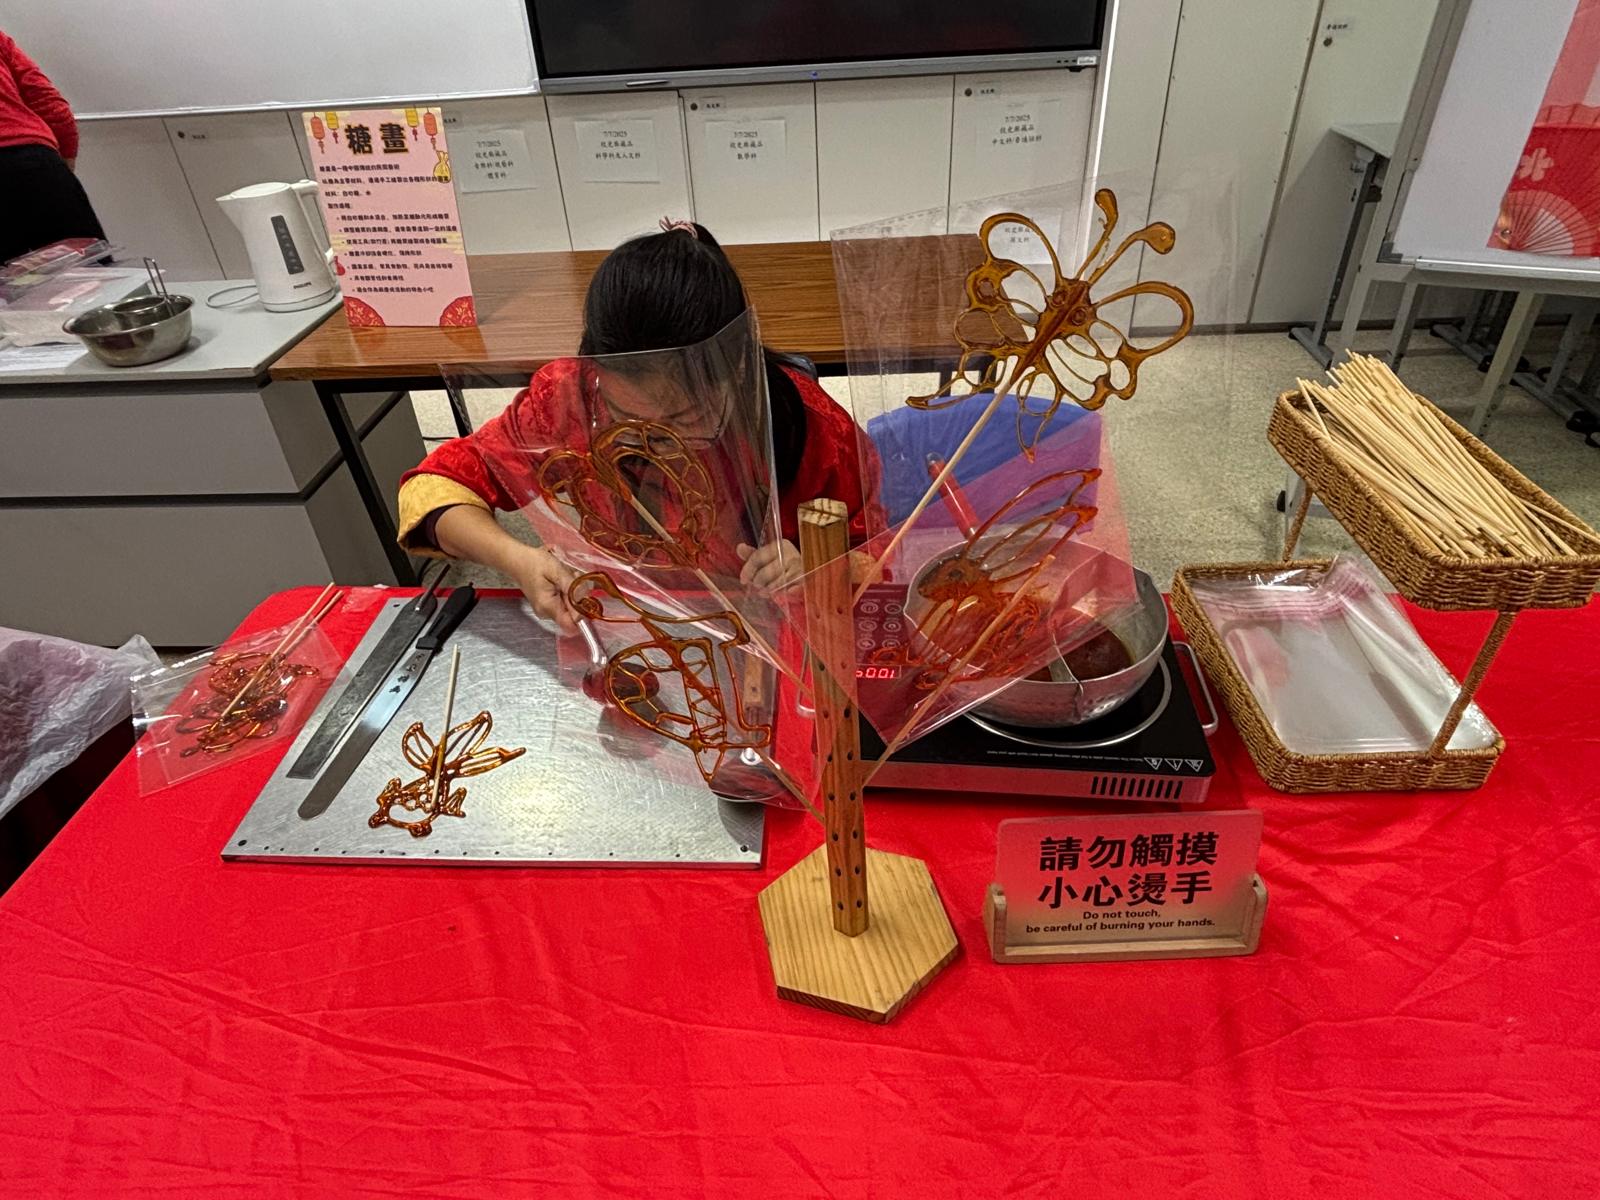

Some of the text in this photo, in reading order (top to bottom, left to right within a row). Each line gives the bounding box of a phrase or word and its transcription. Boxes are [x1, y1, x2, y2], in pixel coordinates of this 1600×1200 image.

[344, 123, 408, 154] 糖畫
[1039, 831, 1219, 872] 請勿觸摸
[1037, 870, 1213, 909] 小心燙手
[1025, 917, 1216, 933] be careful of burning your hands.
[1083, 909, 1161, 920] Do not touch,
